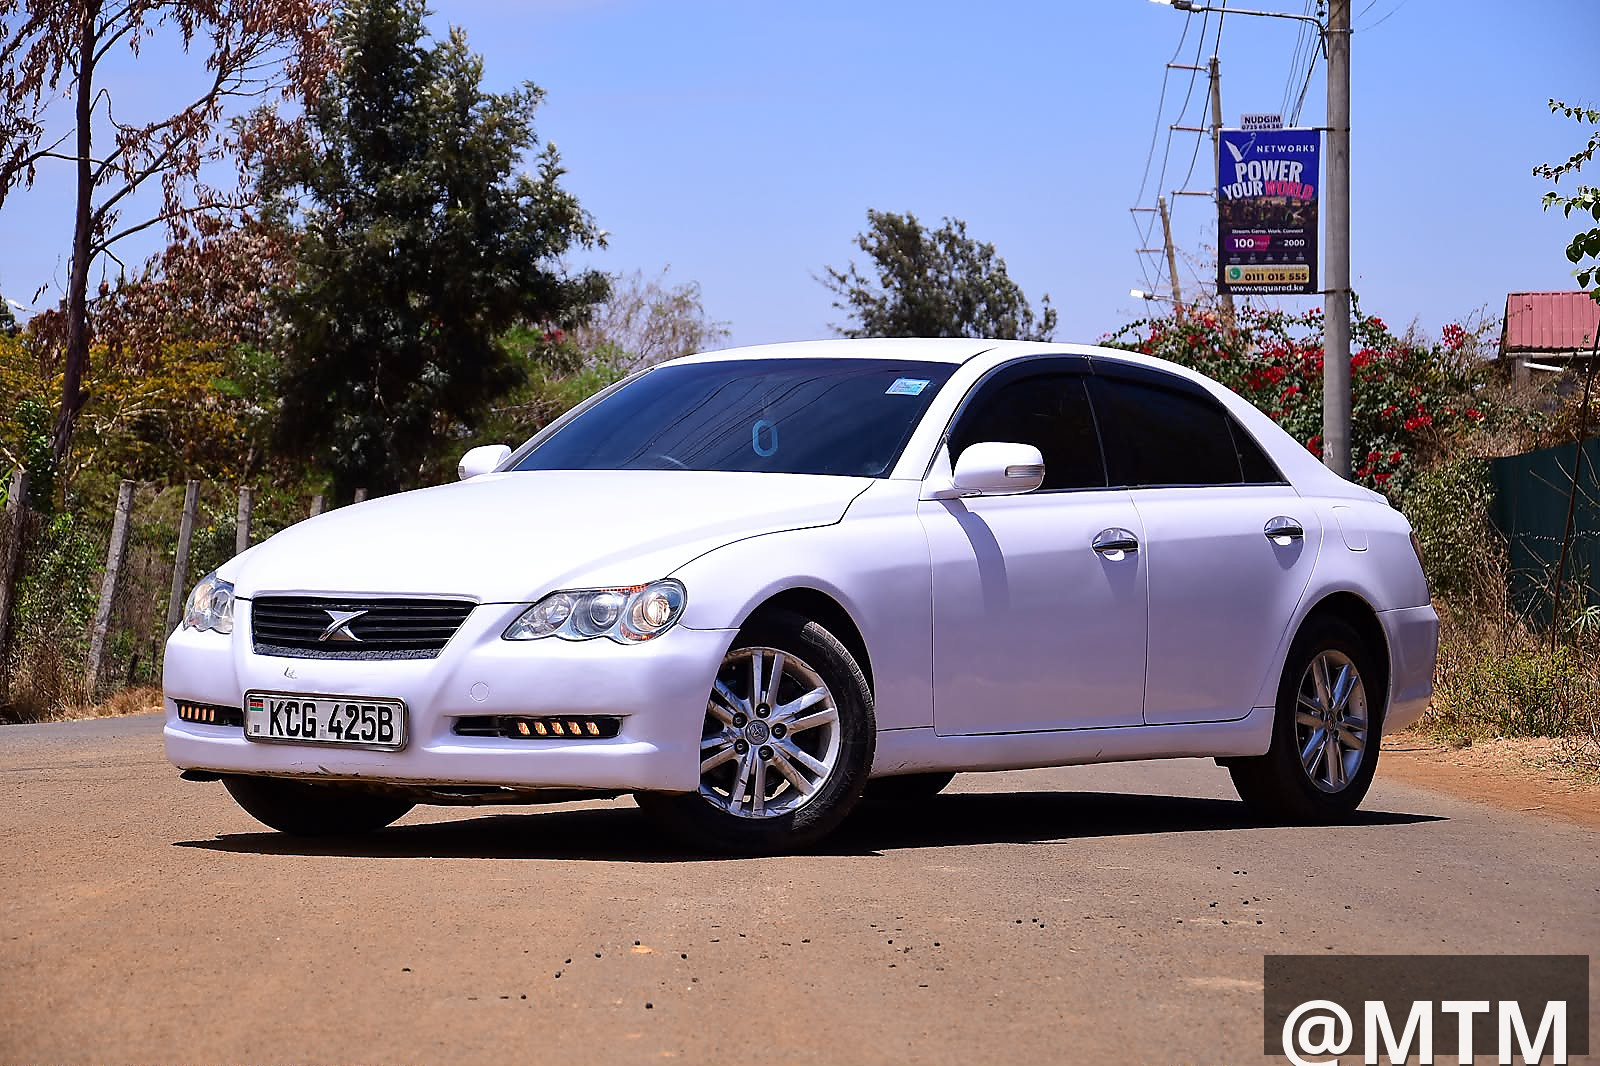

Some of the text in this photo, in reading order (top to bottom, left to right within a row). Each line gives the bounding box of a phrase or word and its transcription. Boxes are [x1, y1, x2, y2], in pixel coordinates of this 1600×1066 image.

[1244, 116, 1281, 124] NUDGIM
[1256, 144, 1315, 153] NETWORKS
[1235, 160, 1304, 183] POWER
[1222, 180, 1314, 201] YOUR WORLD
[1233, 238, 1254, 248] 100
[1284, 239, 1305, 247] 2000
[1245, 272, 1307, 281] 0111 015 555
[1230, 283, 1304, 292] www.vsquared.ke
[269, 700, 394, 742] KCG 425B
